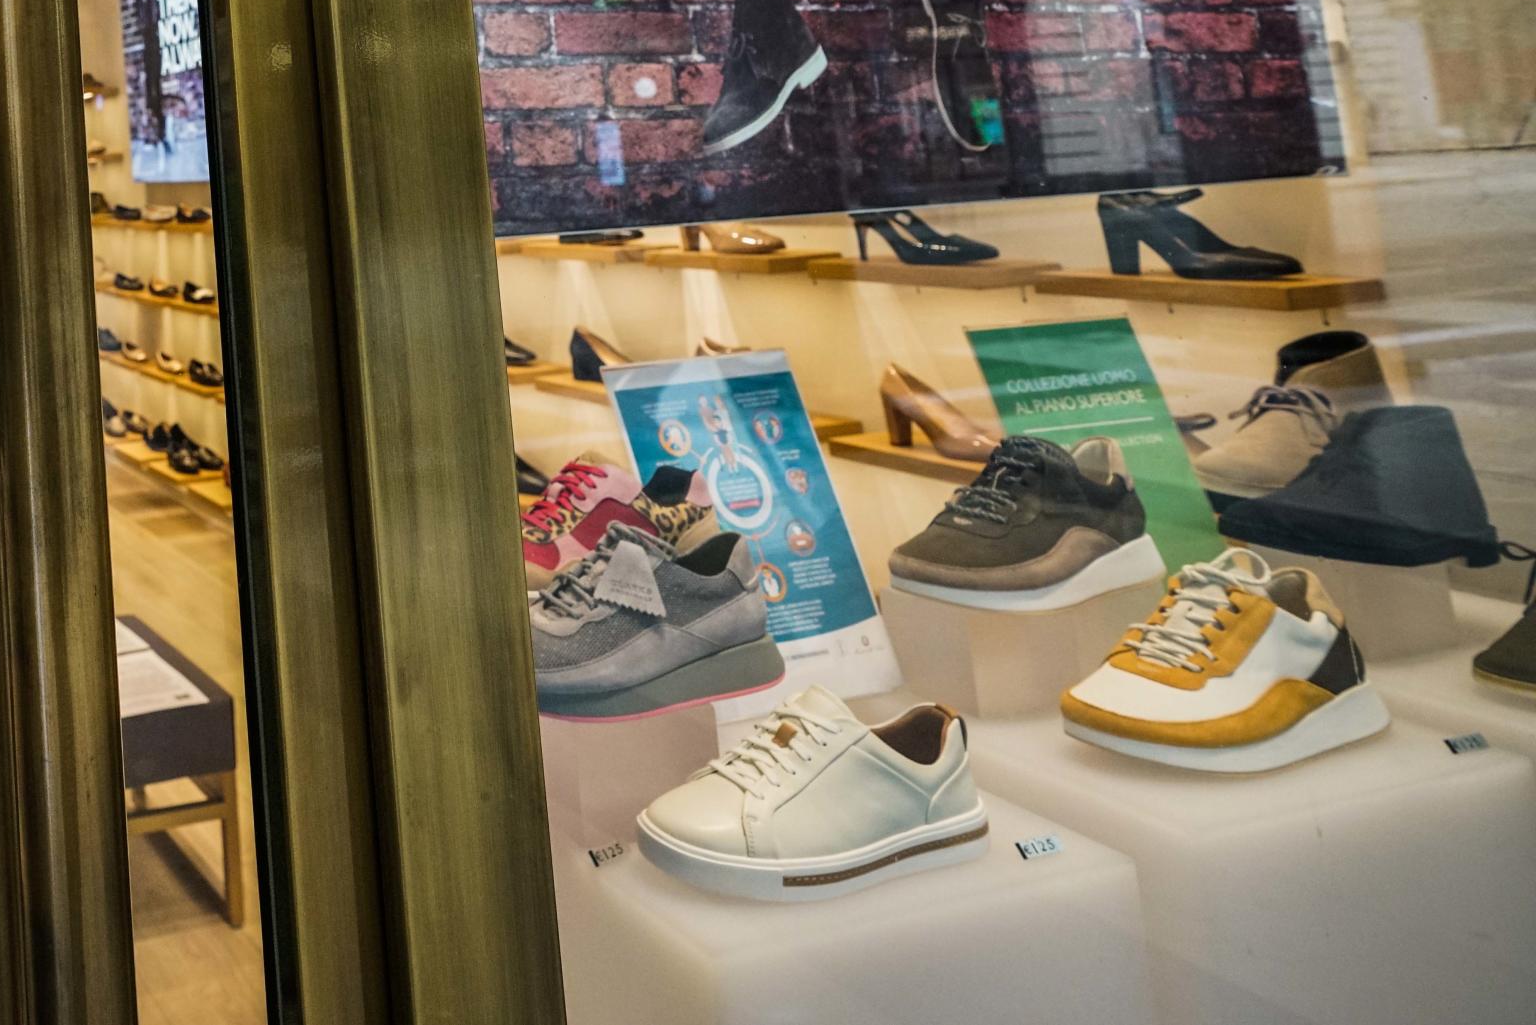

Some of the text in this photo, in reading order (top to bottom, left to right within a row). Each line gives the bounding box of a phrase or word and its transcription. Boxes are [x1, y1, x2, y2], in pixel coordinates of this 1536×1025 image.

[1006, 368, 1137, 394] COLLEZIONE UOMO
[1016, 388, 1148, 416] AL PIANO SUPERIORE
[595, 842, 624, 863] €125
[1023, 837, 1056, 855] €125
